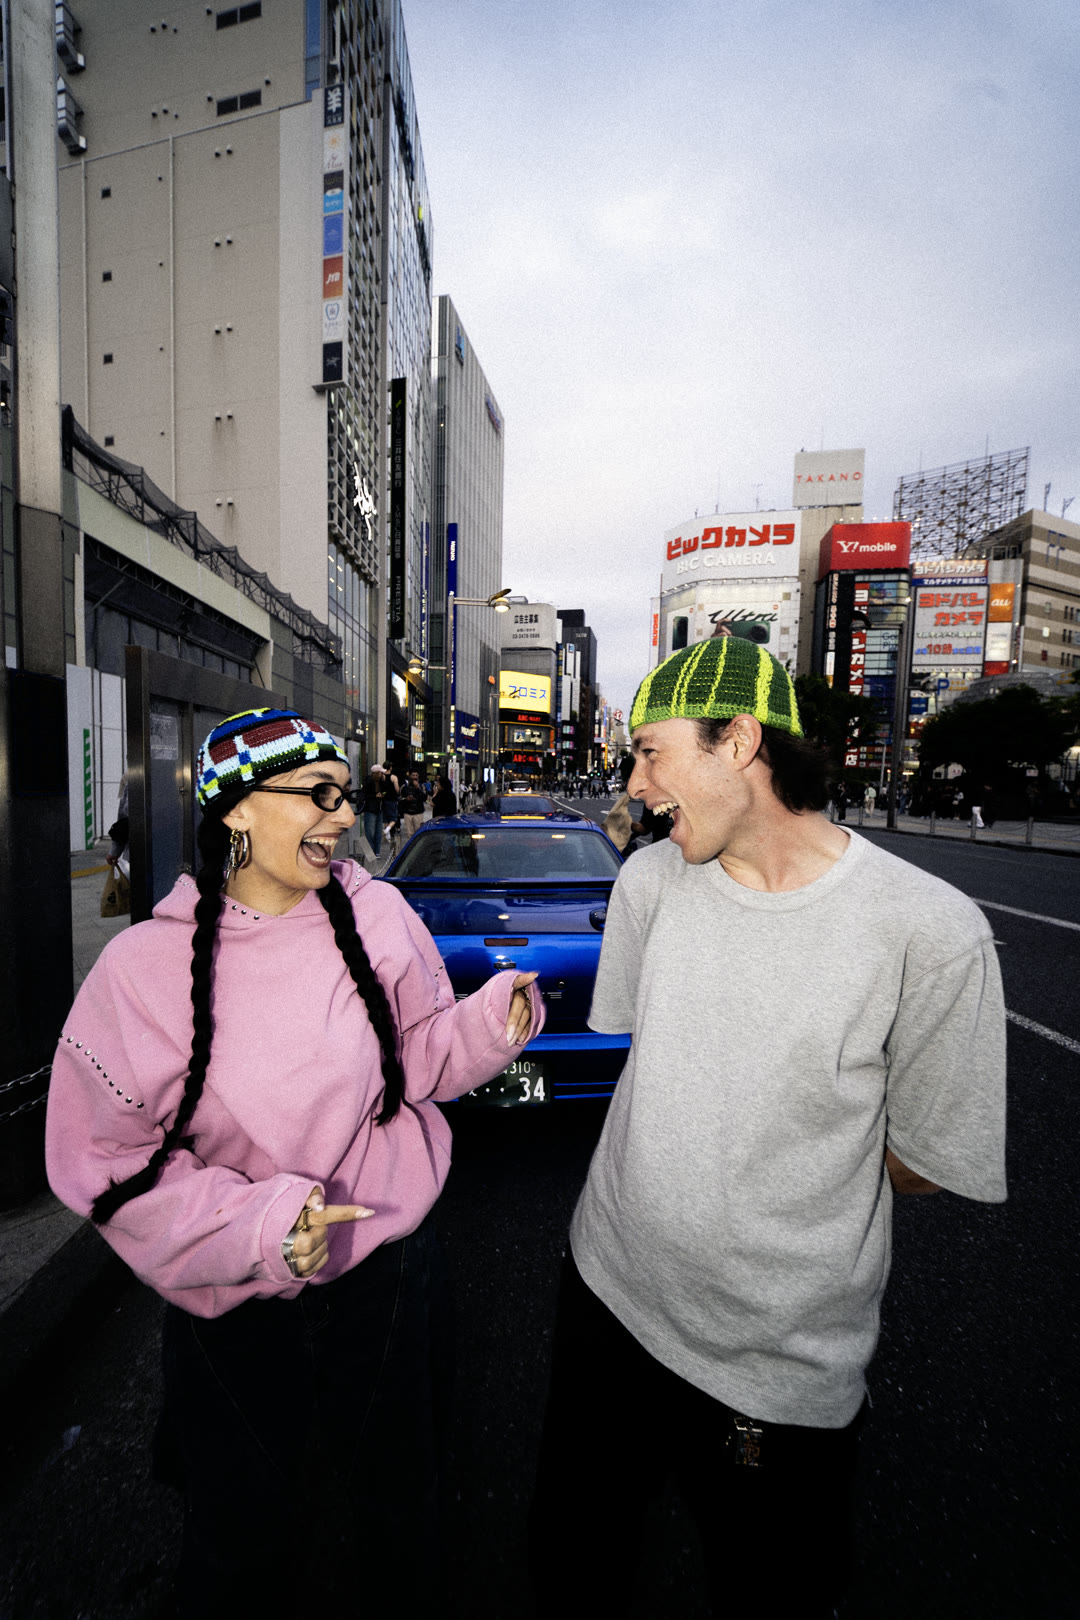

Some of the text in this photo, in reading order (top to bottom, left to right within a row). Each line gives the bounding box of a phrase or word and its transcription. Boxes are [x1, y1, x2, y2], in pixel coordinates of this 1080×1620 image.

[796, 471, 863, 484] TAKANO
[666, 523, 796, 561] ビックカメラ
[676, 550, 776, 575] BIC CAMERA
[914, 563, 986, 575] ヨドバシカメラ
[918, 592, 985, 608] ヨドバシ
[990, 598, 1011, 607] au
[708, 609, 779, 625] Ultra
[934, 611, 985, 627] カメラ
[510, 1061, 531, 1074] 310
[519, 1076, 545, 1102] 34
